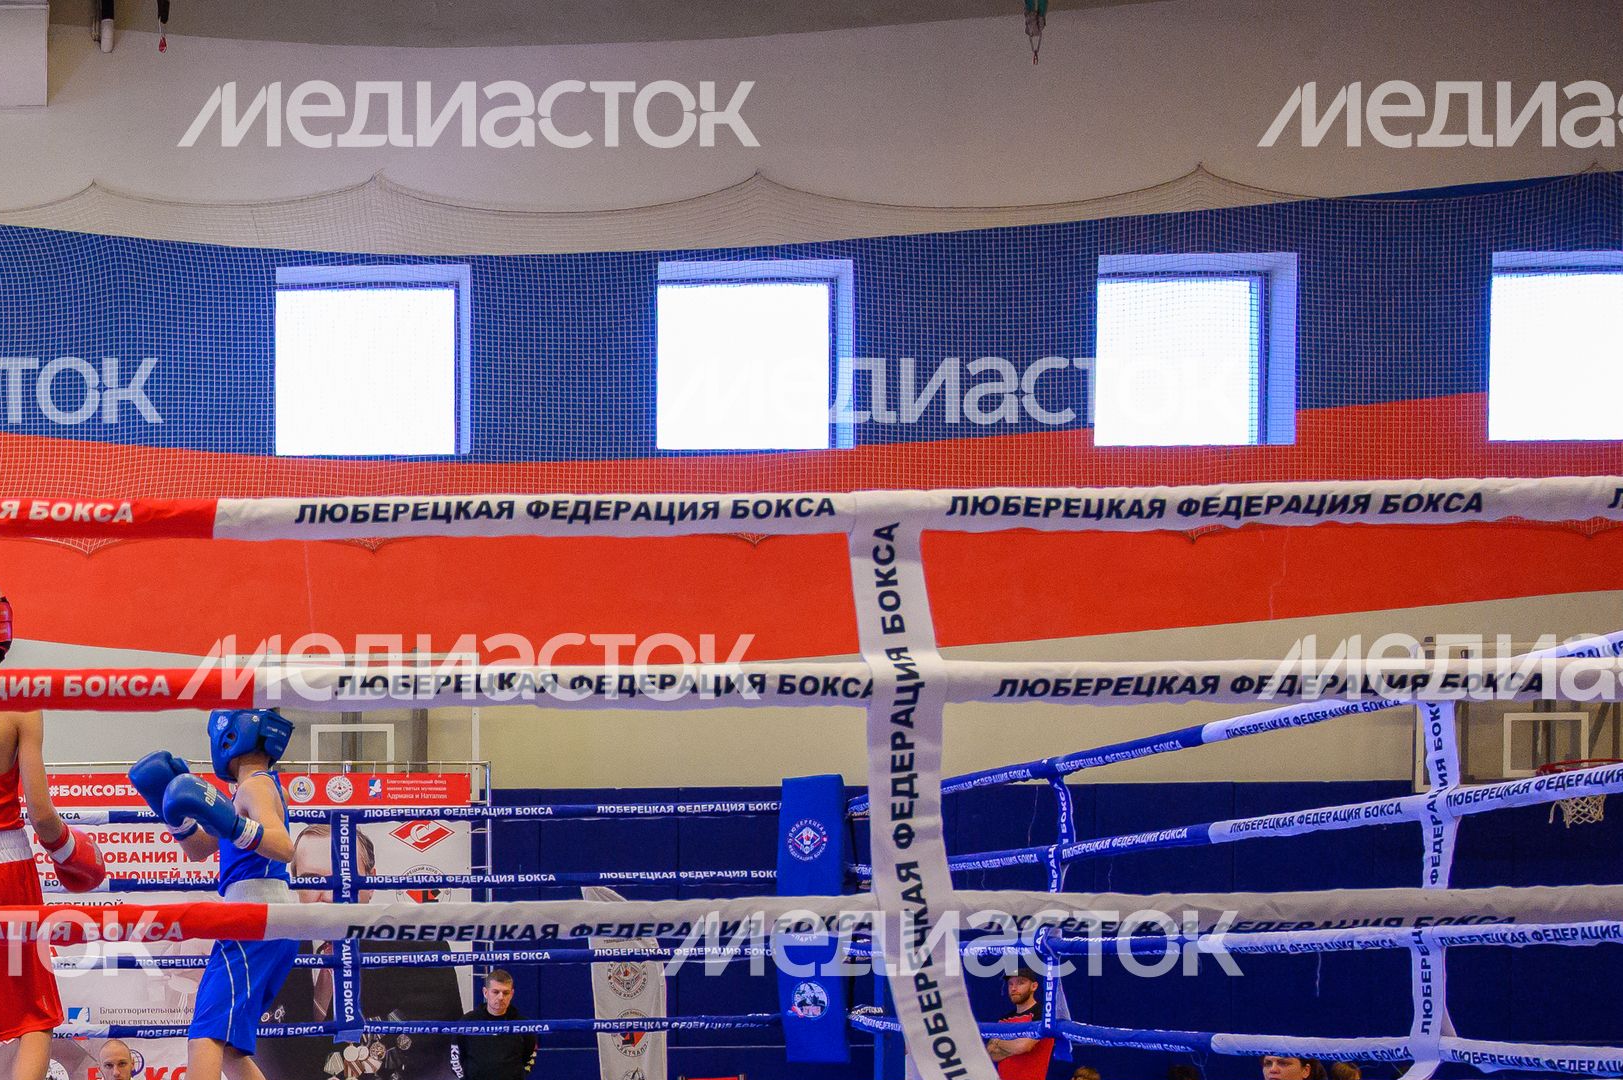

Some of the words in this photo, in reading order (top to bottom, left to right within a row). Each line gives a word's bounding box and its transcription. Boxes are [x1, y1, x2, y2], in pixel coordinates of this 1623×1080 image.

[29, 500, 134, 525] БОКСА
[294, 500, 515, 525] ЛЮБЕРЕЦКАЯ
[524, 498, 722, 525] ФЕДЕРАЦИЯ
[730, 495, 836, 519] БОКСА
[945, 494, 1166, 519] ЛЮБЕРЕЦКАЯ
[1176, 492, 1370, 519] ФЕДЕРАЦИЯ
[1378, 491, 1484, 514] БОКСА
[873, 521, 903, 634] БОКСА
[61, 674, 171, 699] БОКСА
[332, 674, 560, 699] ЛЮБЕРЕЦКАЯ
[569, 673, 768, 698] ФЕДЕРАЦИЯ
[776, 674, 874, 700] БОКСА
[993, 673, 1221, 698] ЛЮБЕРЕЦКАЯ
[1229, 674, 1429, 697] ФЕДЕРАЦИЯ
[1439, 672, 1543, 693] БОКСА
[887, 647, 927, 849] ФЕДЕРАЦИЯ
[1154, 740, 1183, 753] БОКСА
[386, 792, 412, 800] Адриана
[1446, 781, 1532, 807] ЛЮБЕРЕЦКАЯ
[1534, 769, 1623, 791] ФЕДЕРАЦИЯ
[289, 810, 326, 818] БОКСА
[364, 808, 441, 818] ЛЮБЕРЕЦКАЯ
[443, 807, 514, 818] ФЕДЕРАЦИЯ
[515, 807, 554, 816] БОКСА
[597, 804, 674, 814] ЛЮБЕРЕЦКАЯ
[677, 803, 746, 813] ФЕДЕРАЦИЯ
[1229, 814, 1293, 835] ЛЮБЕРЕЦКАЯ
[1295, 804, 1363, 828] ФЕДЕРАЦИЯ
[1363, 802, 1403, 820] БОКСА
[1062, 840, 1111, 859] ЛЮБЕРЕЦКАЯ
[1111, 832, 1158, 849] ФЕДЕРАЦИЯ
[1159, 828, 1188, 842] БОКСА
[340, 814, 351, 898] ЛЮБЕРЕЦКАЯ
[1018, 854, 1039, 864] БОКСА
[290, 876, 327, 884] БОКСА
[365, 875, 442, 884] ЛЮБЕРЕЦКАЯ
[445, 874, 515, 884] ФЕДЕРАЦИЯ
[517, 873, 556, 882] БОКСА
[599, 871, 676, 879] ЛЮБЕРЕЦКАЯ
[679, 870, 748, 879] ФЕДЕРАЦИЯ
[82, 920, 184, 941] БОКСА
[569, 918, 763, 939] ФЕДЕРАЦИЯ
[774, 912, 876, 934] БОКСА
[1440, 930, 1530, 946] ЛЮБЕРЕЦКАЯ
[1531, 925, 1622, 943] ФЕДЕРАЦИЯ
[362, 955, 439, 965] ЛЮБЕРЕЦКАЯ
[441, 953, 510, 964] ФЕДЕРАЦИЯ
[512, 951, 551, 961] БОКСА
[594, 948, 670, 957] ЛЮБЕРЕЦКАЯ
[672, 947, 741, 956] ФЕДЕРАЦИЯ
[344, 979, 354, 1022] БОКСА
[288, 1025, 324, 1035] БОКСА
[364, 1025, 440, 1034] ЛЮБЕРЕЦКАЯ
[513, 1024, 550, 1033] БОКСА
[593, 1022, 668, 1030] ЛЮБЕРЕЦКАЯ
[1373, 1046, 1412, 1061] БОКСА
[1451, 1050, 1541, 1069] ЛЮБЕРЕЦКАЯ
